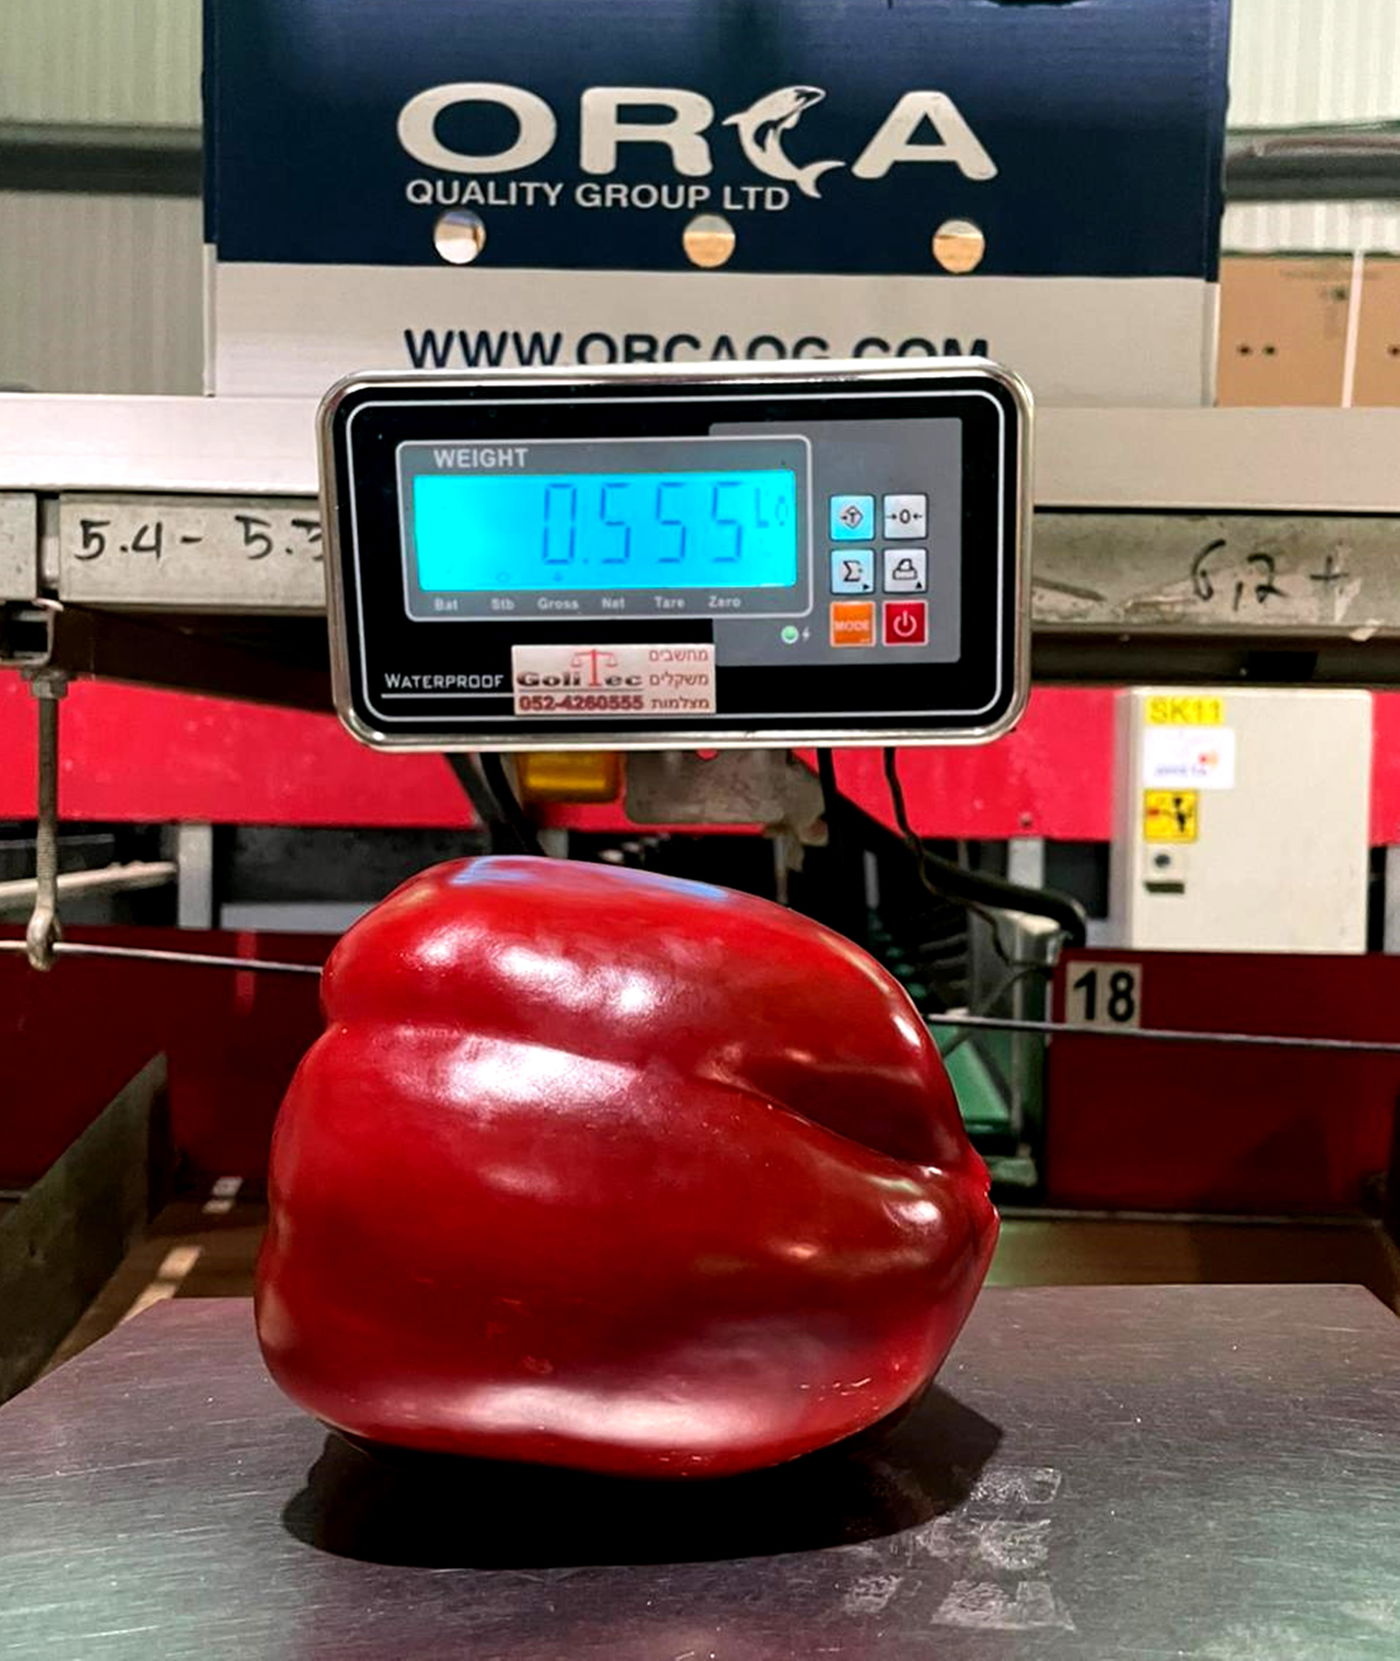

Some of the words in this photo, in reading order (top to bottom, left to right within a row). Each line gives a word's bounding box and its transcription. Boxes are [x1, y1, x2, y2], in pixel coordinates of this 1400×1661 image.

[405, 179, 563, 207] QUALITY
[575, 182, 711, 209] GROUP
[723, 186, 790, 211] LTD
[433, 448, 529, 469] WEIGHT
[542, 483, 744, 564] 0.555
[73, 518, 163, 560] 5.4
[434, 598, 458, 611] Bat
[490, 598, 515, 611] Stb
[537, 597, 580, 611] Gross
[602, 598, 625, 610] Net
[654, 596, 685, 609] Tare
[708, 595, 742, 608] Zero
[834, 619, 870, 632] MODE
[649, 649, 709, 662] מחשבים
[649, 670, 710, 689] משקלים
[650, 696, 710, 710] מצלמות
[1150, 699, 1221, 725] SK11
[1073, 967, 1136, 1023] 18
